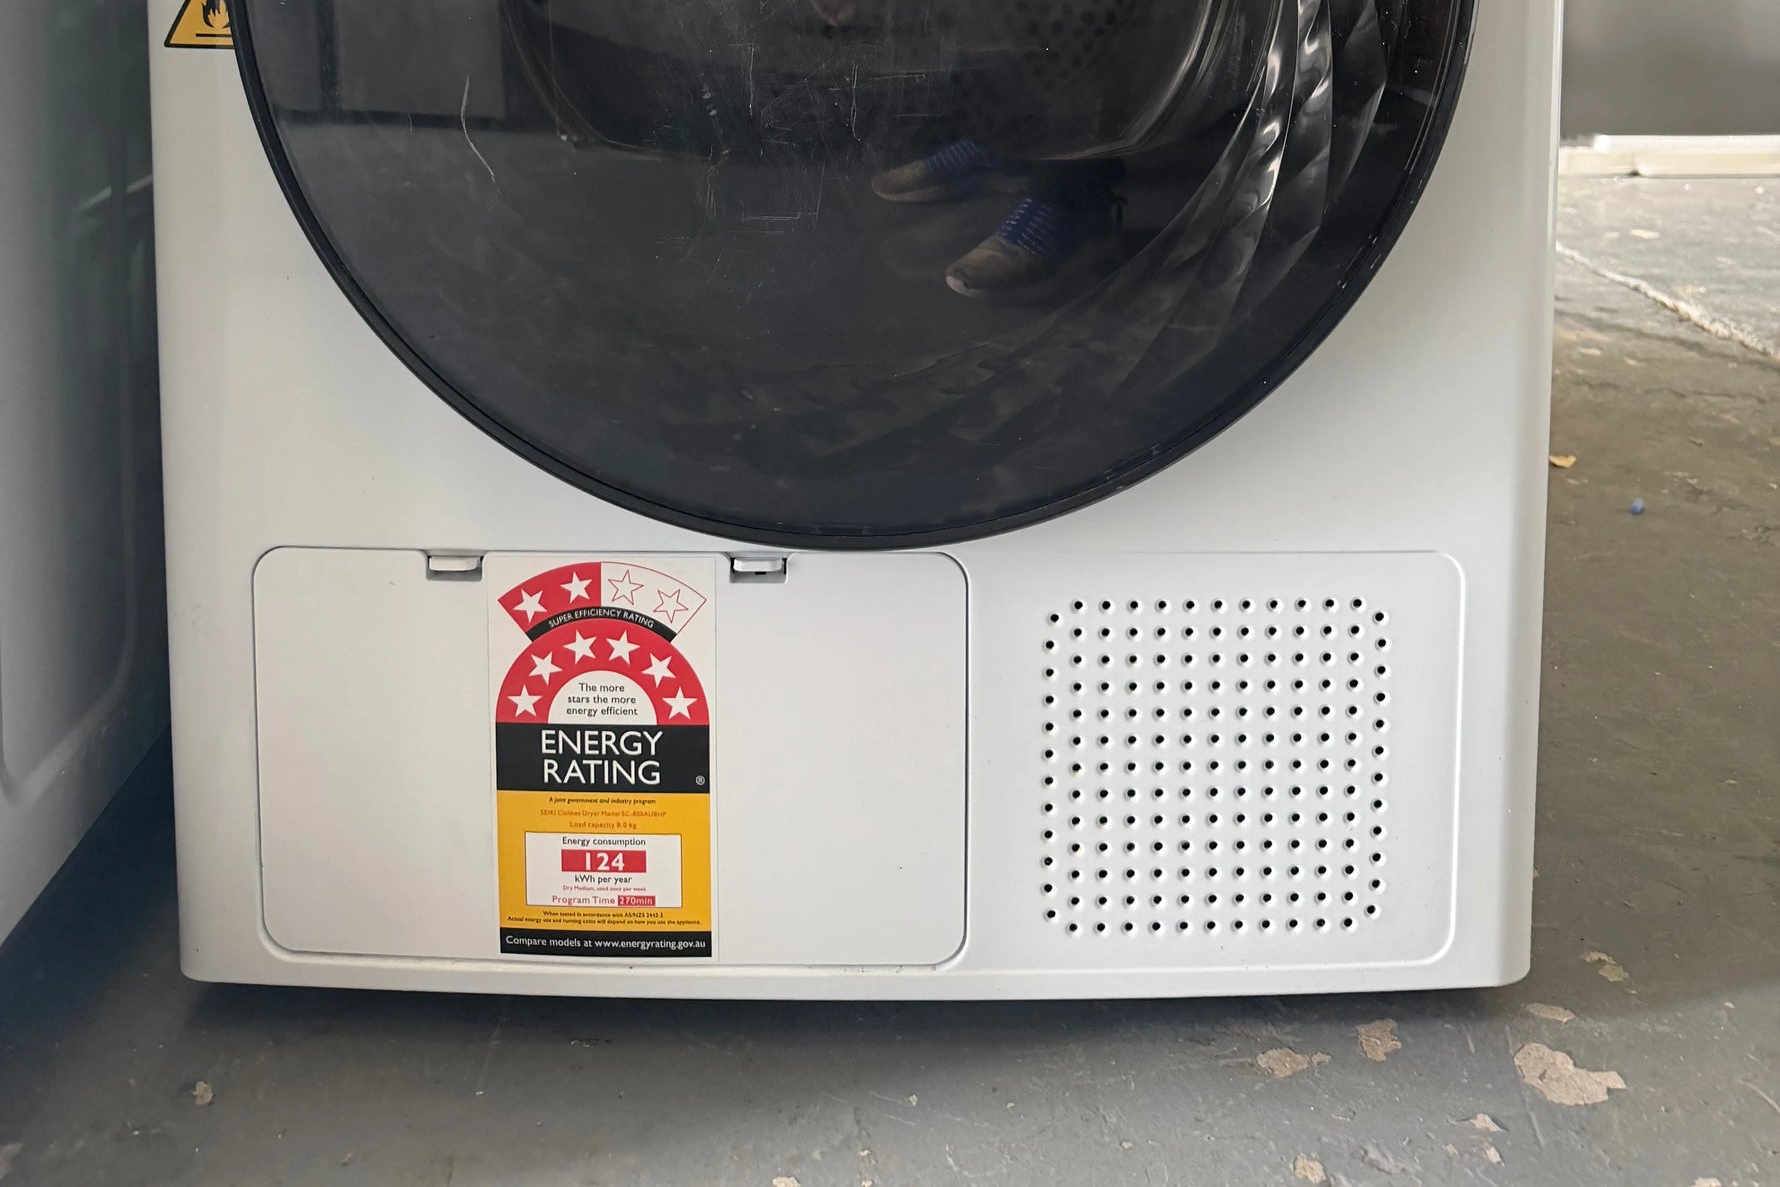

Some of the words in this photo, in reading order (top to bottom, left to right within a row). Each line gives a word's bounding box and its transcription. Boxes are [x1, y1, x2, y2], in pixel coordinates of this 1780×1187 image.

[548, 612, 574, 628] SUPER
[575, 608, 622, 619] EFFICIENCY
[623, 612, 655, 628] RATING
[579, 682, 597, 692] The
[593, 695, 608, 703] the
[566, 708, 598, 717] energy
[601, 706, 638, 715] efficient
[541, 730, 663, 756] ENERGY
[543, 758, 661, 785] RATING
[629, 822, 637, 830] kg
[562, 836, 590, 847] Energy
[593, 838, 646, 848] consumption
[585, 852, 625, 871] 124
[575, 874, 595, 883] kWh
[598, 876, 612, 885] per
[614, 877, 632, 885] year
[552, 895, 590, 905] Program
[592, 895, 615, 904] Time
[619, 897, 653, 905] 270min
[505, 935, 547, 947] Compare
[549, 937, 581, 947] models
[594, 939, 706, 950] www.energyrating.gov.au
